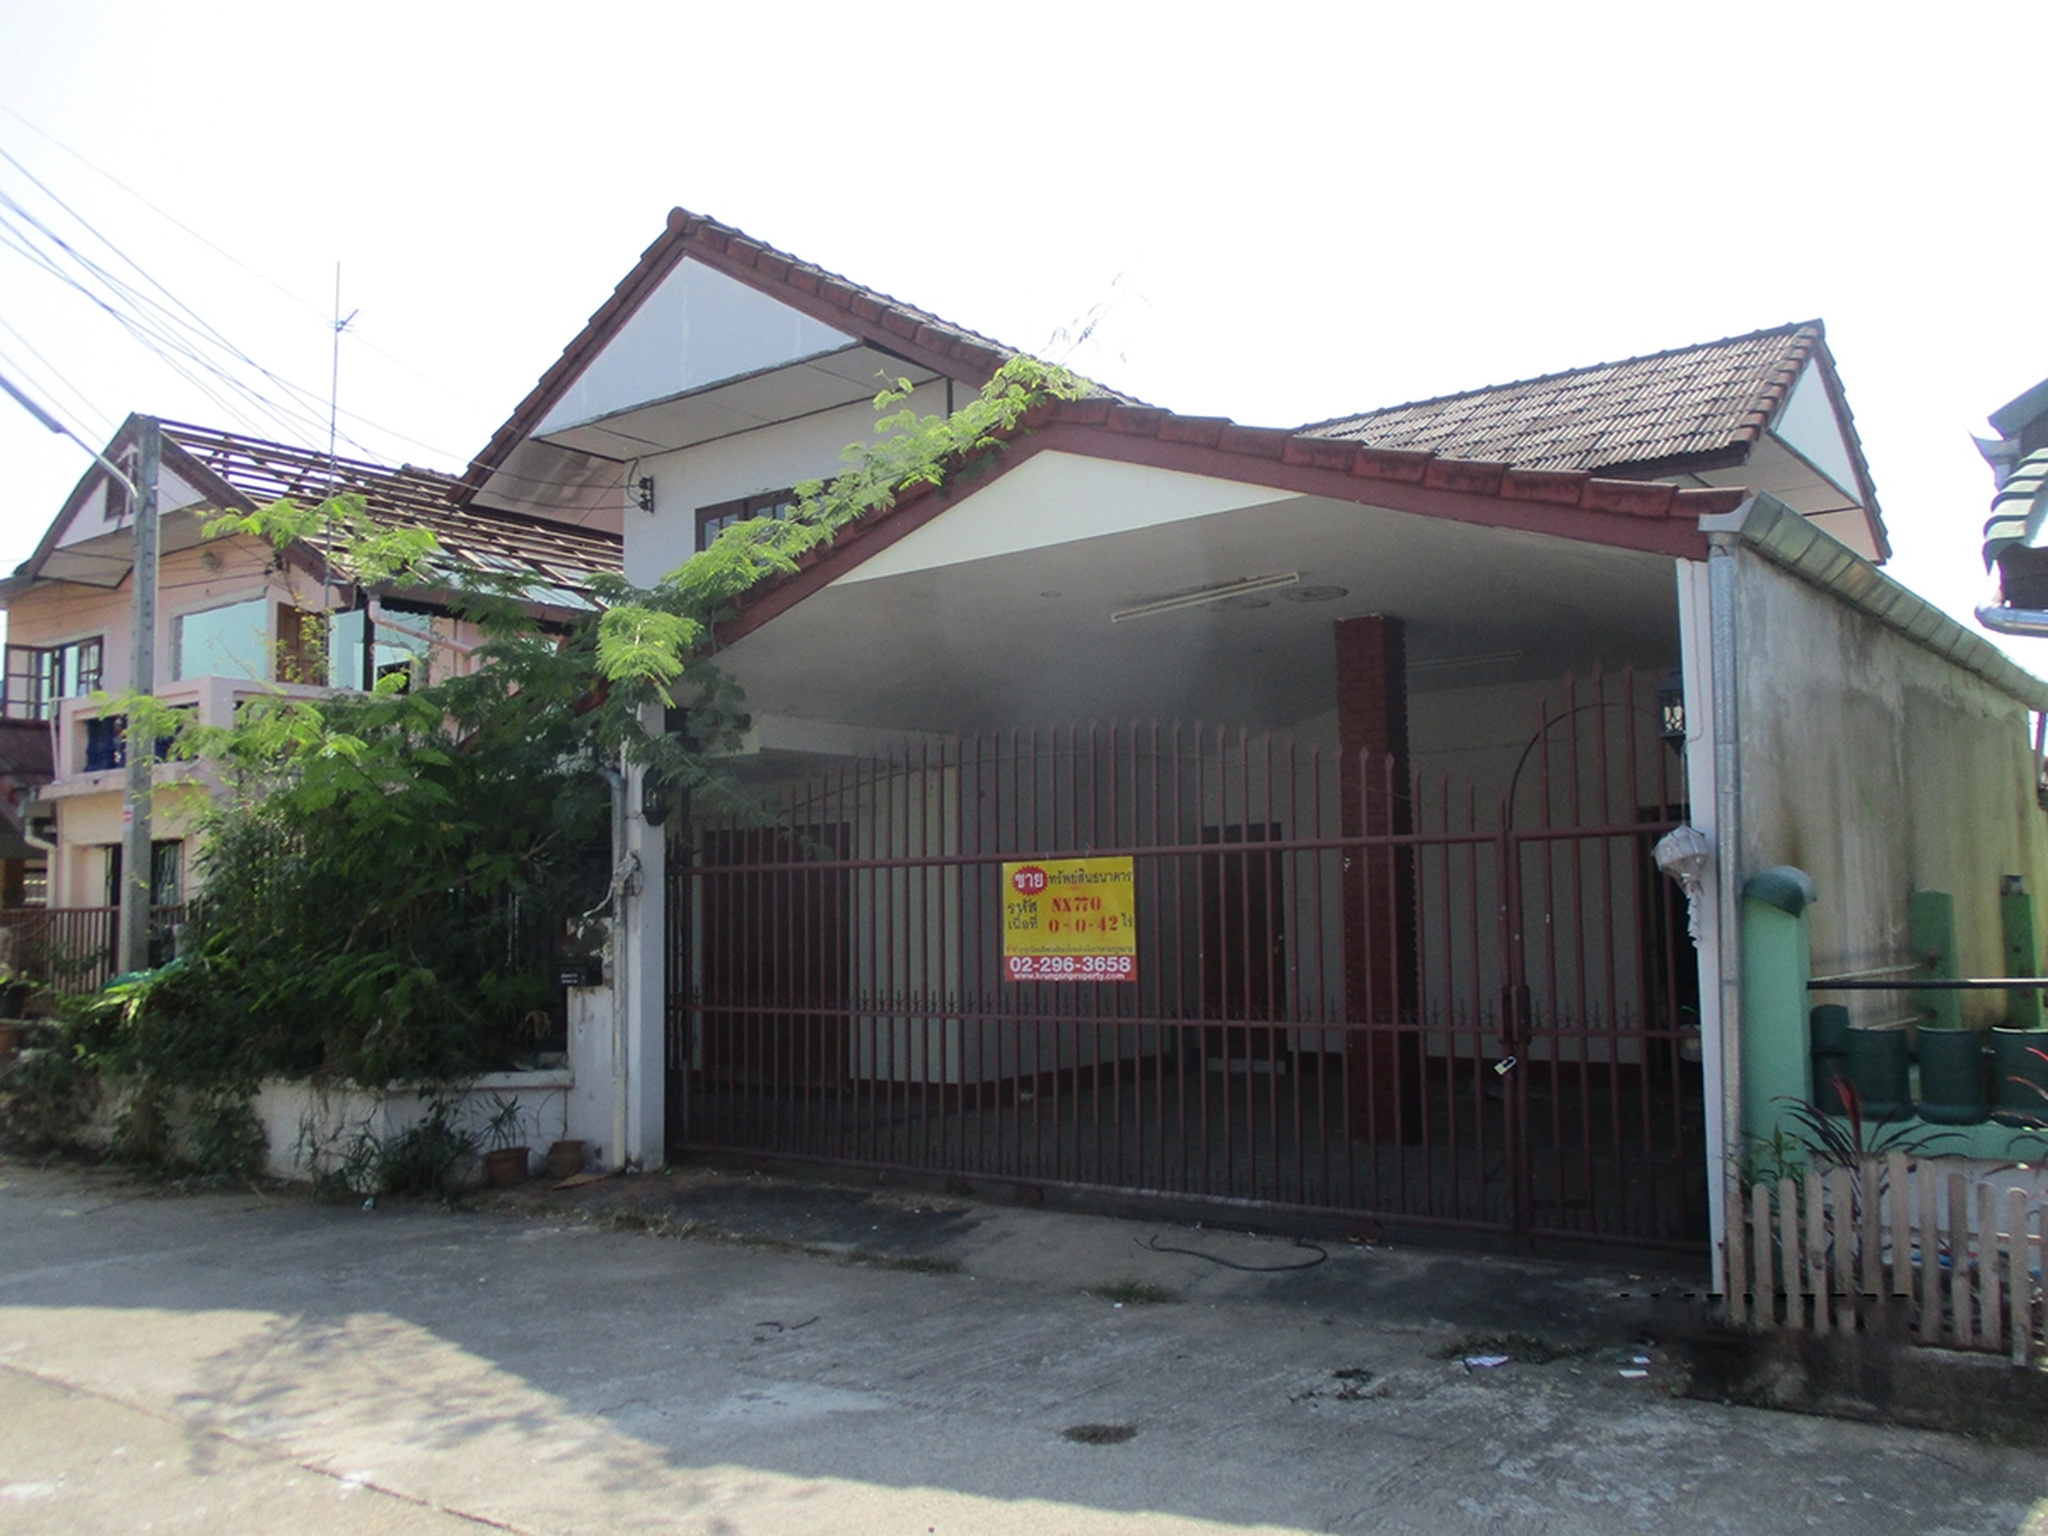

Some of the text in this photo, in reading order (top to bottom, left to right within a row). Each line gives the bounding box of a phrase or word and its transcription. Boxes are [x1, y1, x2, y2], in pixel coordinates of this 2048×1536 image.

[1014, 873, 1044, 888] ขาย
[1007, 896, 1102, 914] รหัส NX770
[1009, 956, 1132, 973] 02-296-3658
